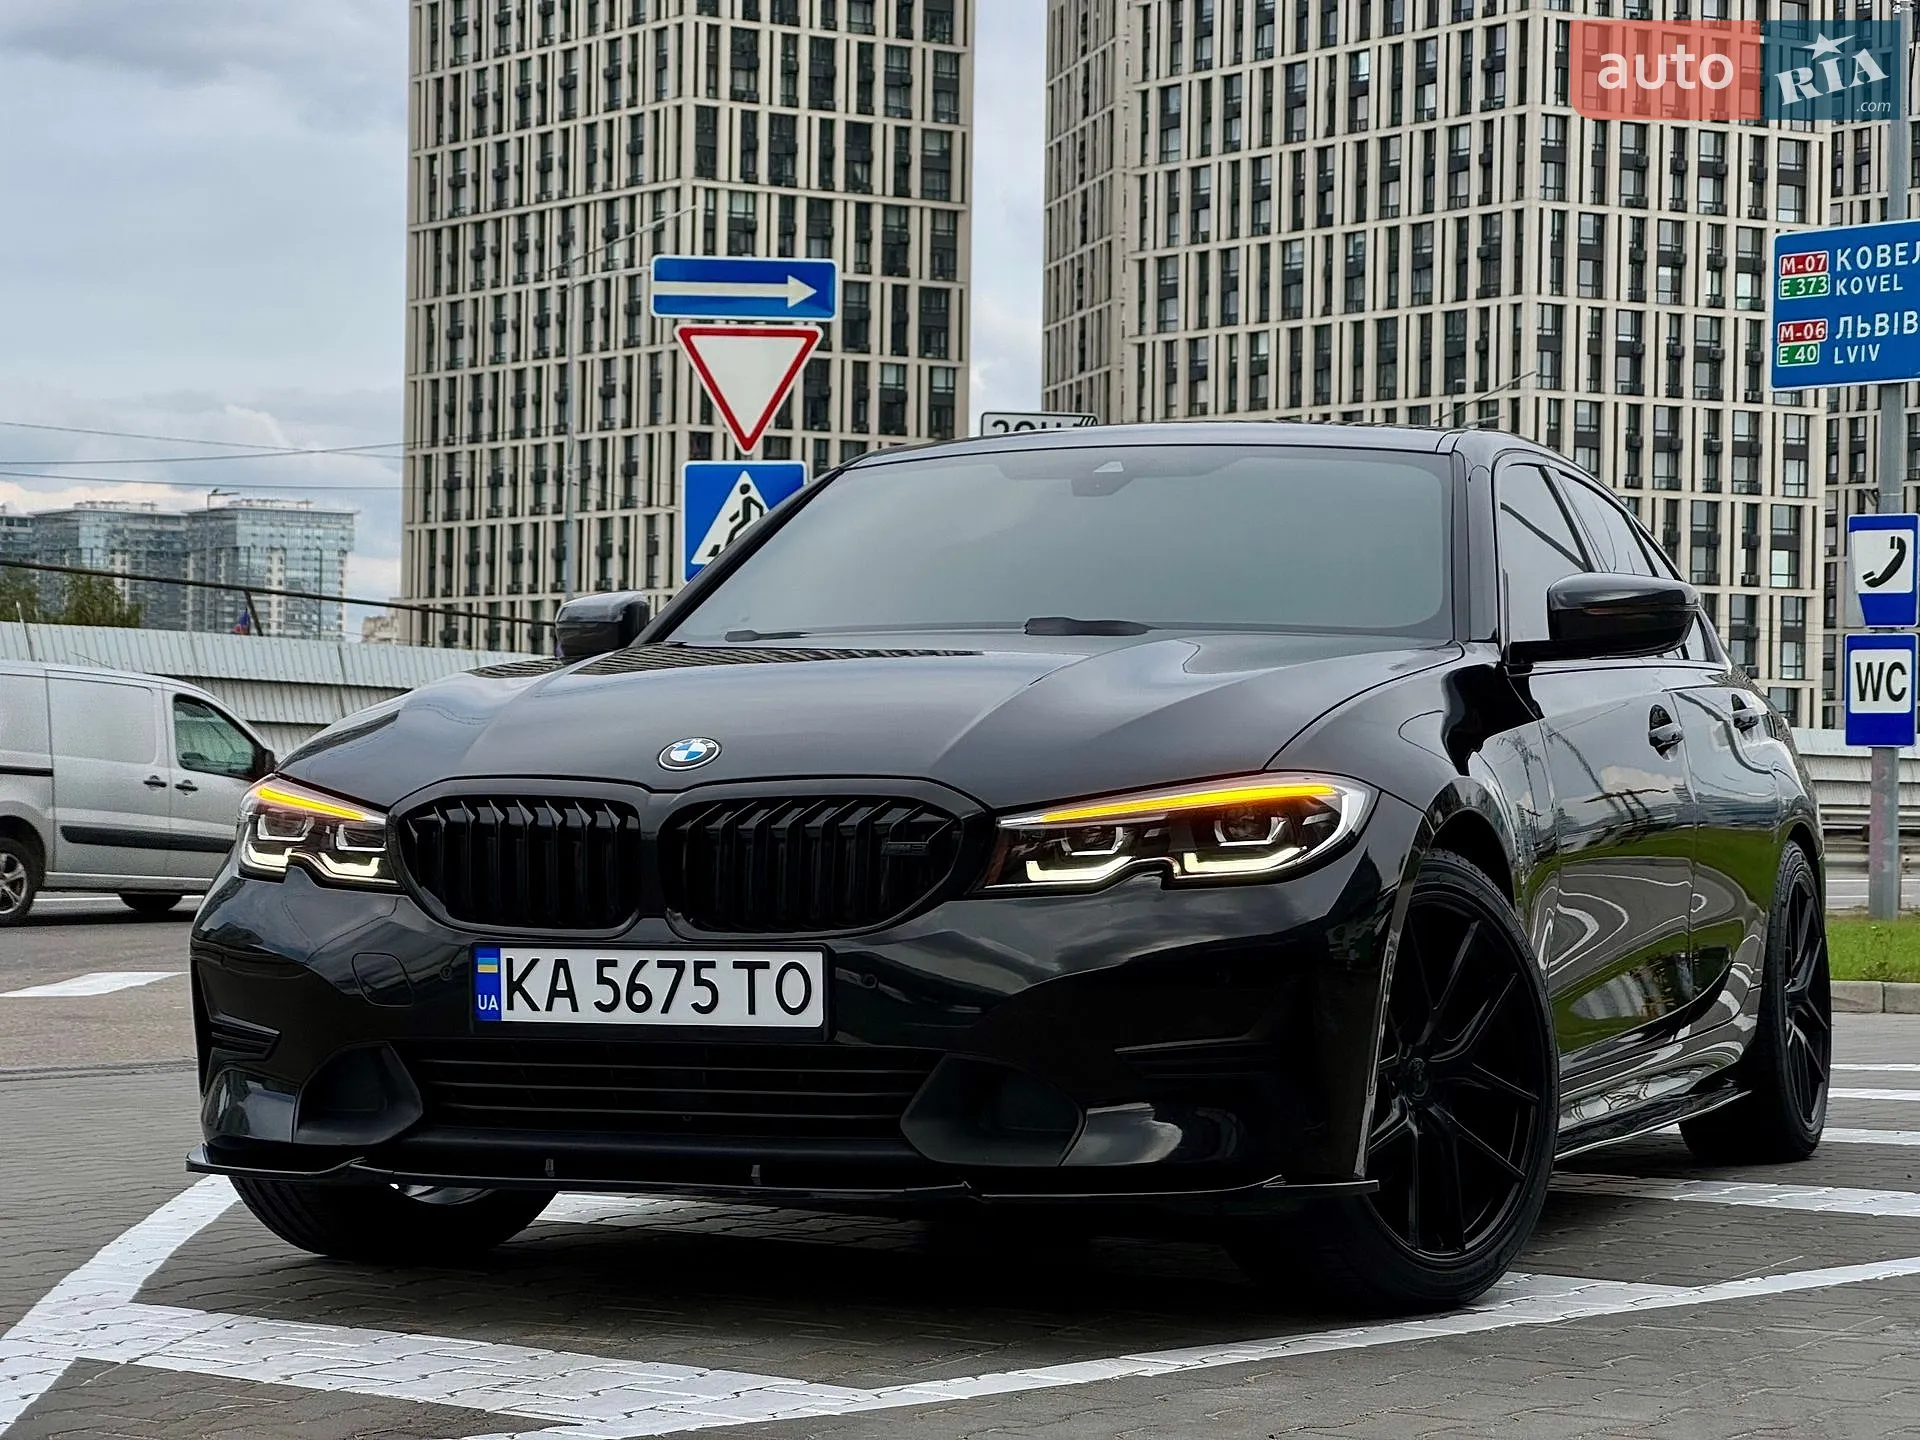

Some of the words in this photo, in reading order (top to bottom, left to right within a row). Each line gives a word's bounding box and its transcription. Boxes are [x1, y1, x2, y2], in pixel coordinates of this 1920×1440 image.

[1781, 253, 1827, 275] M-07
[1780, 279, 1791, 296] E
[1796, 276, 1828, 295] 373
[1836, 273, 1904, 296] KOVEL
[1780, 321, 1826, 342] M-06
[1835, 310, 1919, 340] ЛЬВІВ
[1779, 347, 1789, 364] E
[1794, 345, 1817, 362] 40
[1834, 343, 1881, 364] LVIV
[1855, 661, 1908, 702] WC
[505, 957, 579, 1013] KA
[593, 958, 719, 1015] 5675
[732, 960, 813, 1016] TO
[477, 994, 499, 1012] UA
